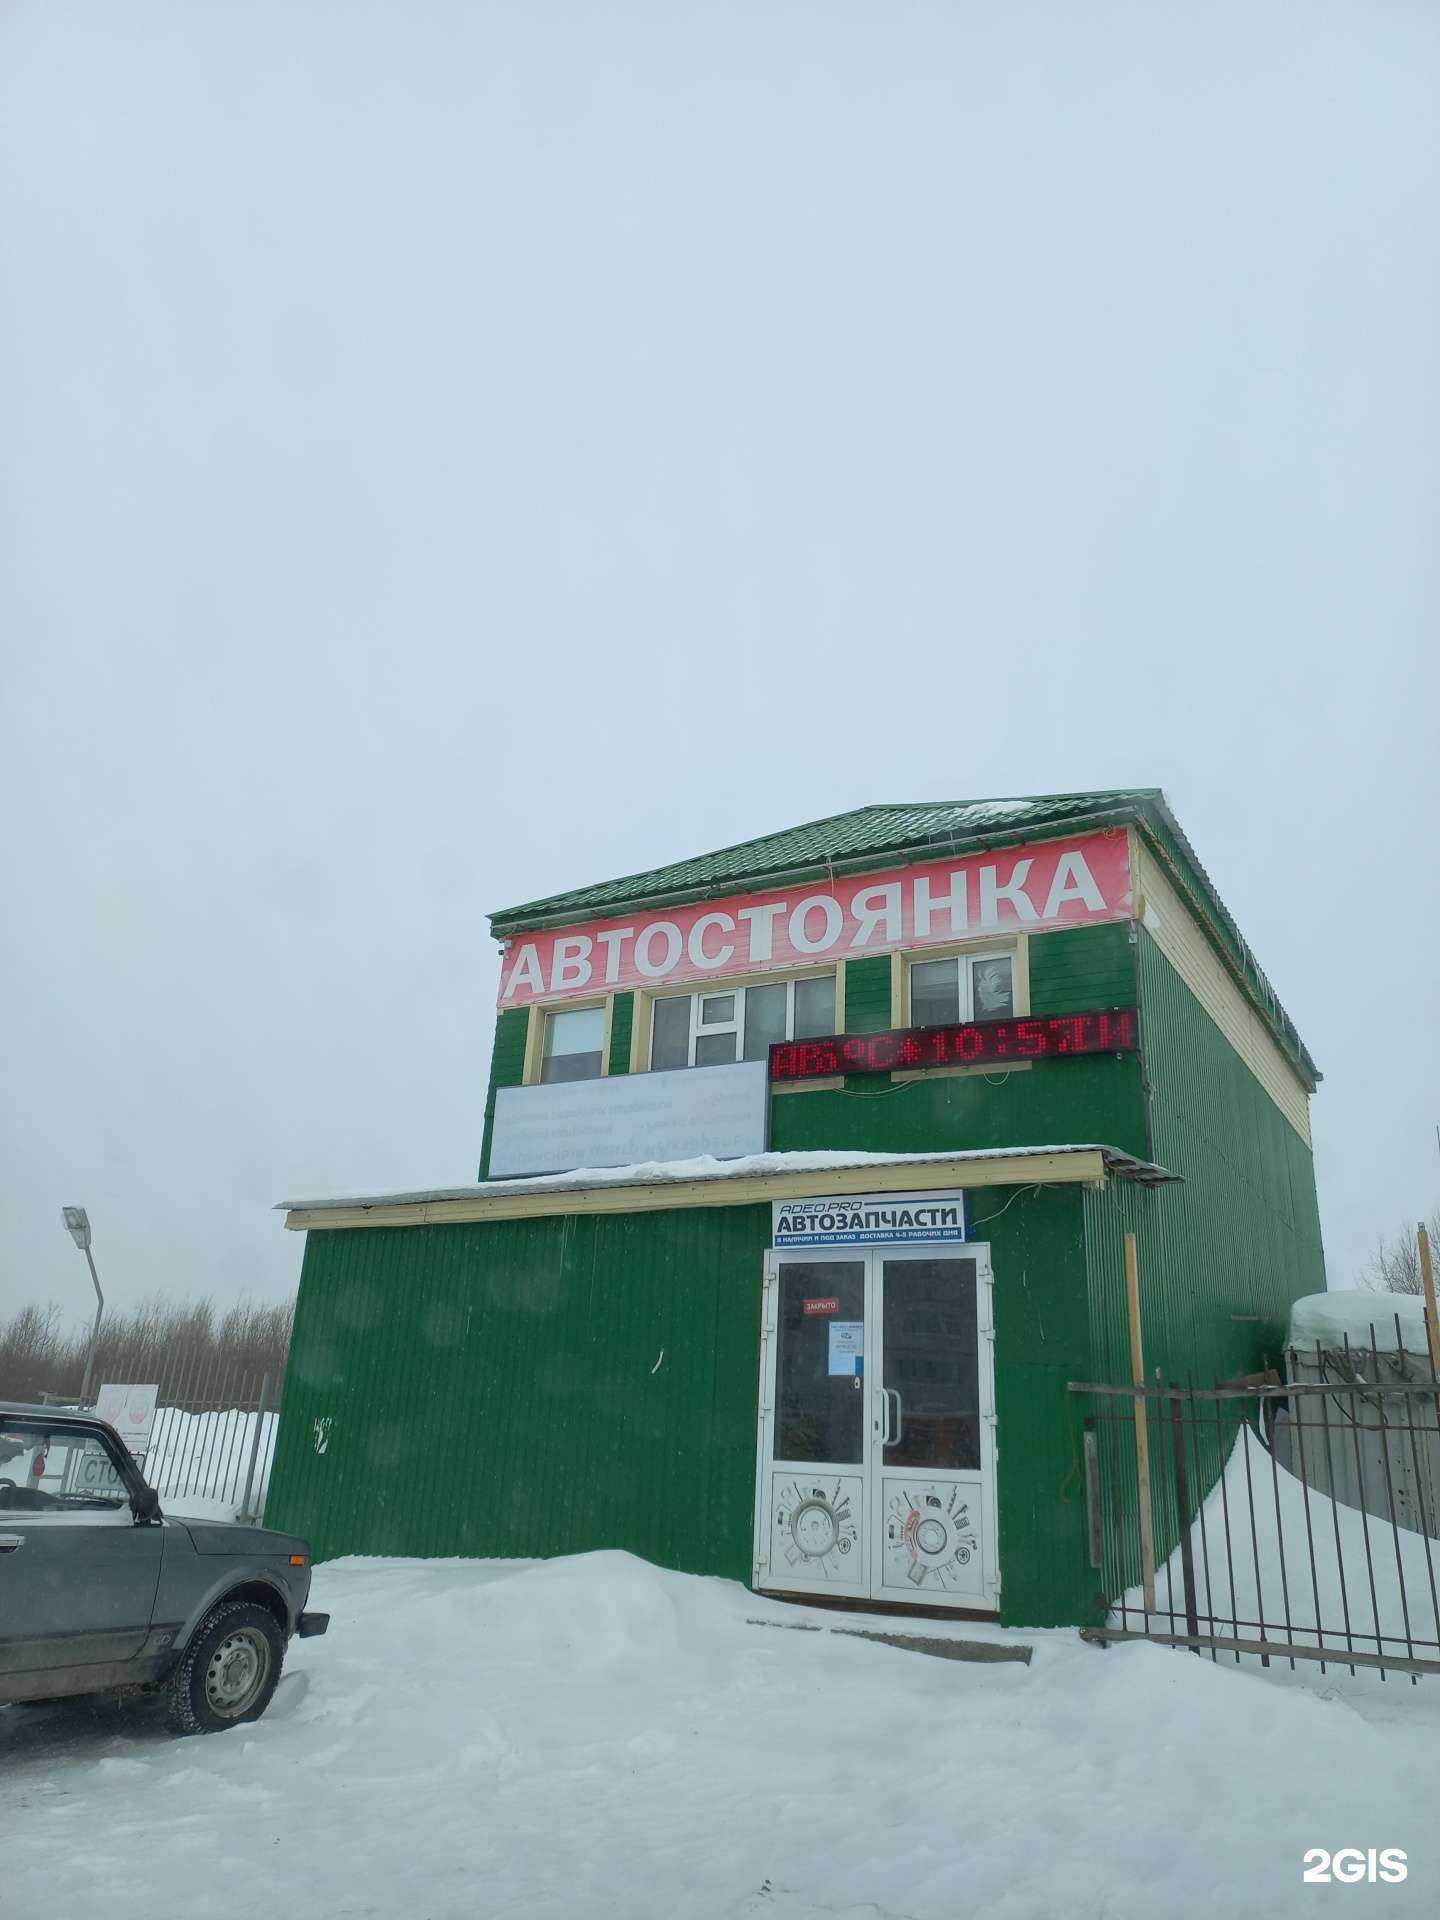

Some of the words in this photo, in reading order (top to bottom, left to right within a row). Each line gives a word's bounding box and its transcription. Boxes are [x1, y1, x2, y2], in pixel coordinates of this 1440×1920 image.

[503, 850, 1107, 998] АВТОСТОЯНКА
[779, 1201, 863, 1215] ADEO.PRO
[777, 1207, 958, 1233] АВТОЗАПЧАСТИ
[806, 1301, 836, 1311] ЗАКРЫТО
